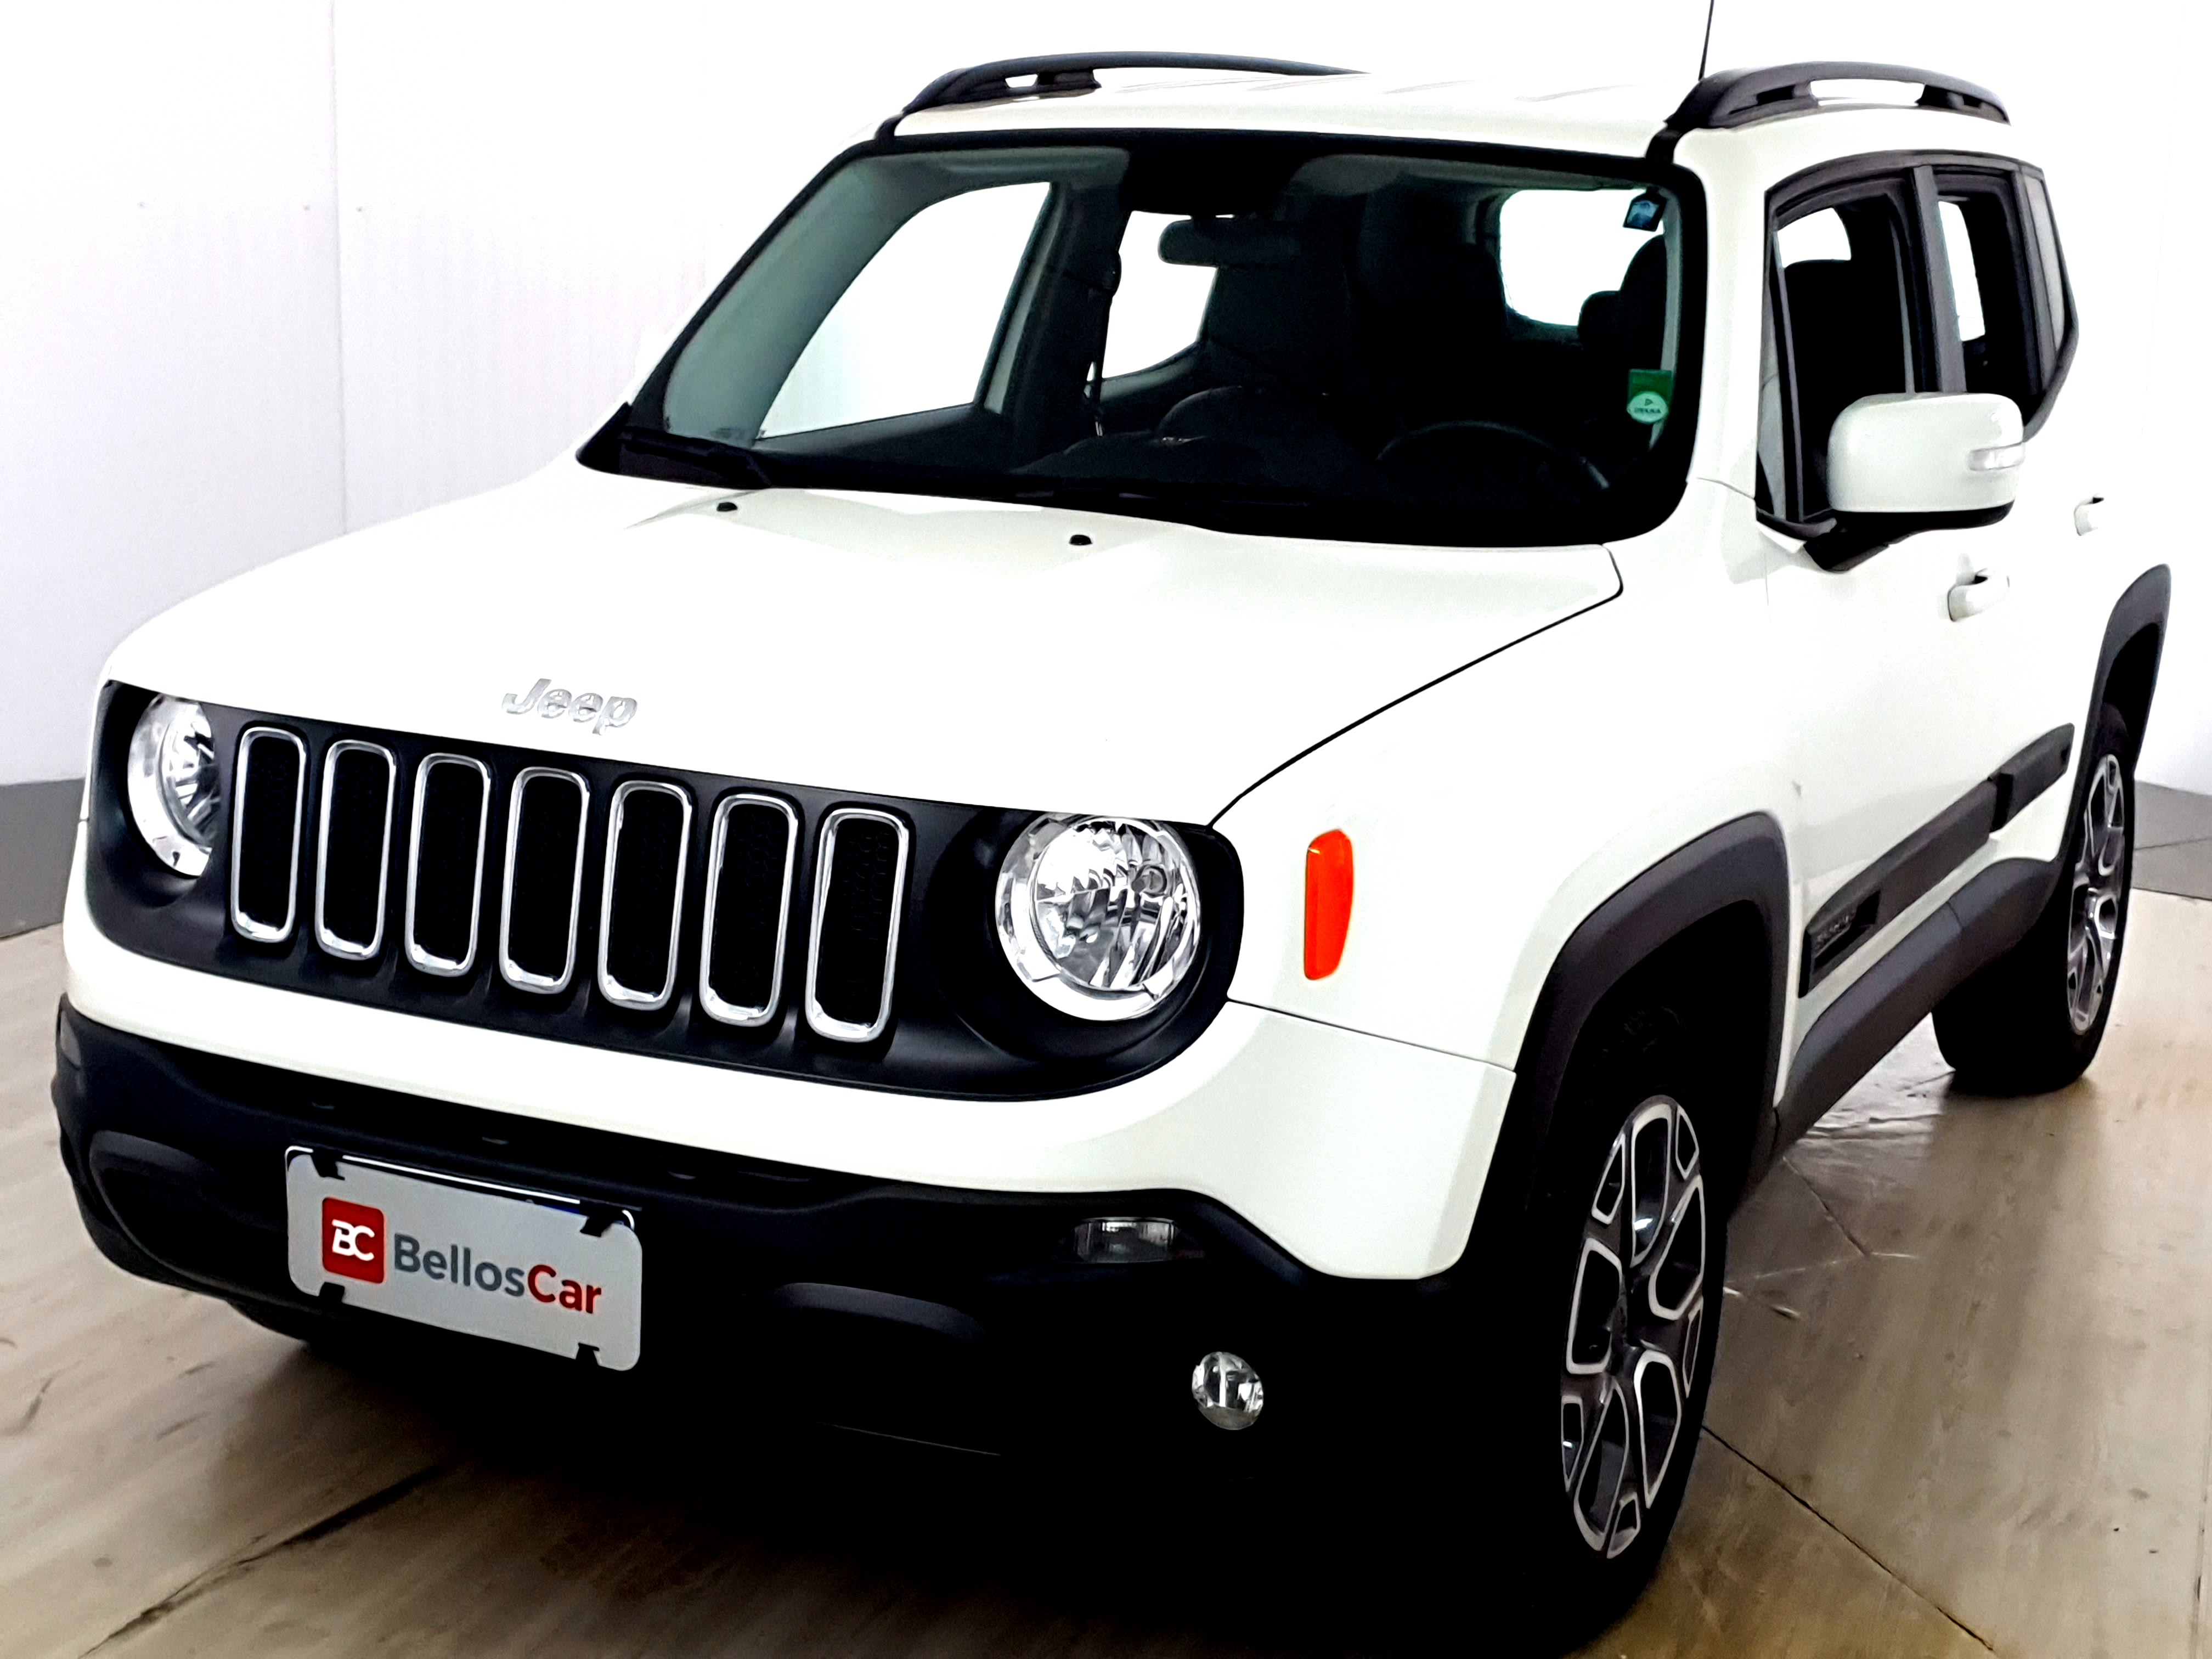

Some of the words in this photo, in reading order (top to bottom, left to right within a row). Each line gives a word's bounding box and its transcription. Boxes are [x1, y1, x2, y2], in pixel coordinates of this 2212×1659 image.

[502, 678, 637, 735] Jeep
[331, 1219, 375, 1261] BC
[394, 1233, 602, 1314] BellosCar
